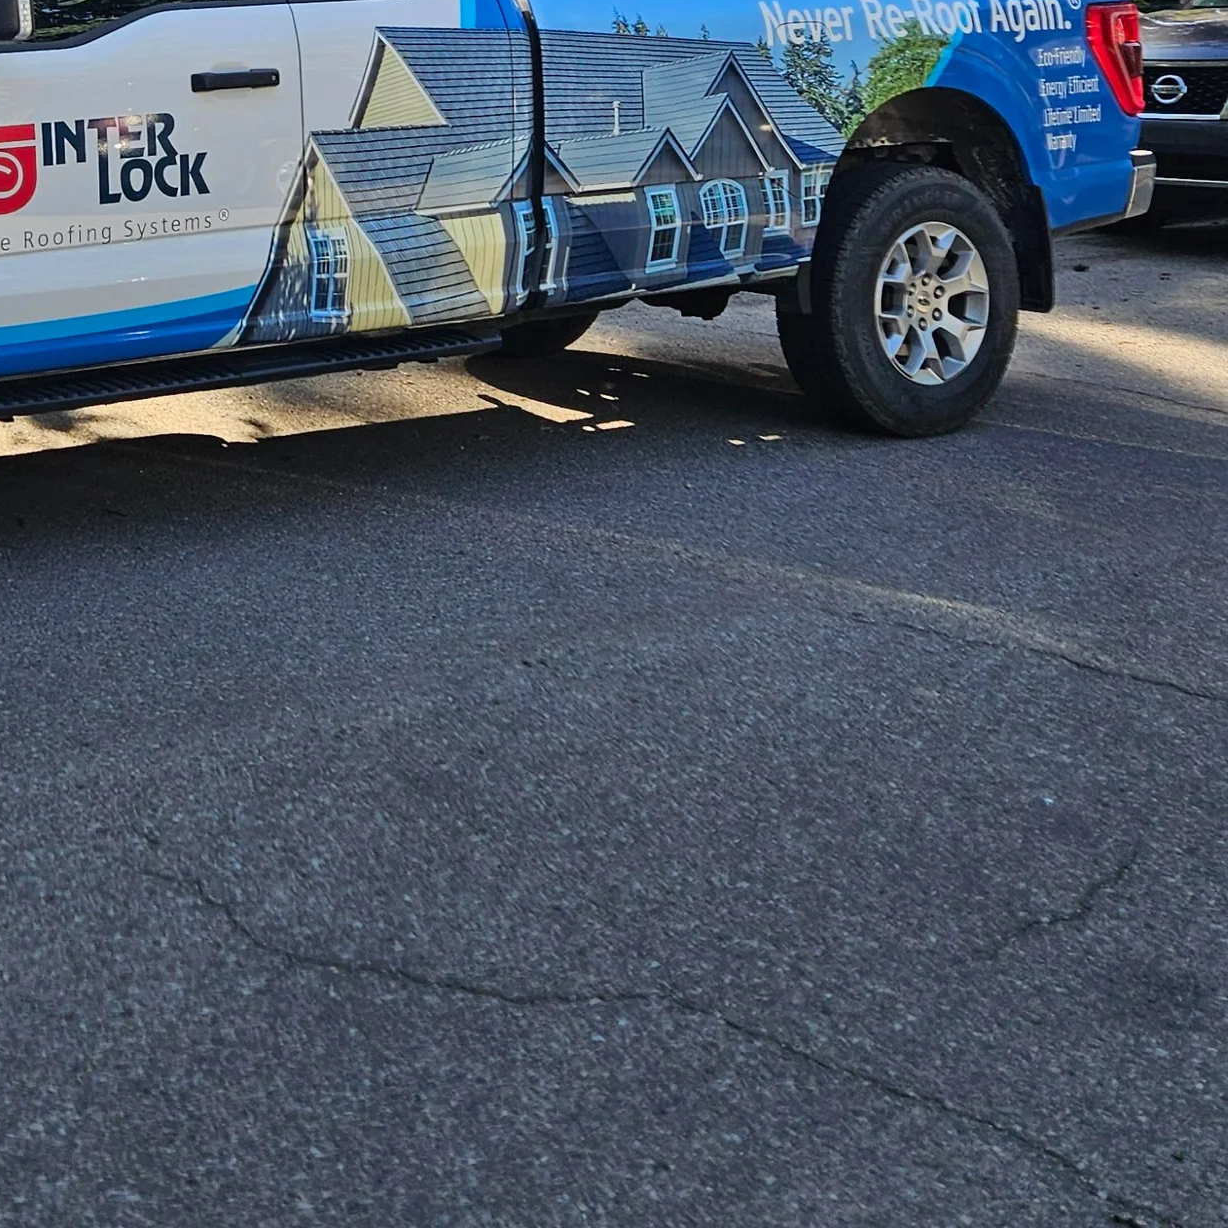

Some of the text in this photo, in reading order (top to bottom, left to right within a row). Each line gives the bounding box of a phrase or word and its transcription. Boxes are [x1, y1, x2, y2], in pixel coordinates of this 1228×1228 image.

[757, 0, 854, 47] Never
[1036, 45, 1086, 67] Eco-Friendly
[1039, 75, 1100, 99] Energy Efficient
[1043, 104, 1102, 127] Lifetime Limited
[40, 112, 178, 166] INTER
[1045, 130, 1077, 152] Warranty
[98, 151, 211, 205] LOCK
[23, 222, 113, 249] Roofing
